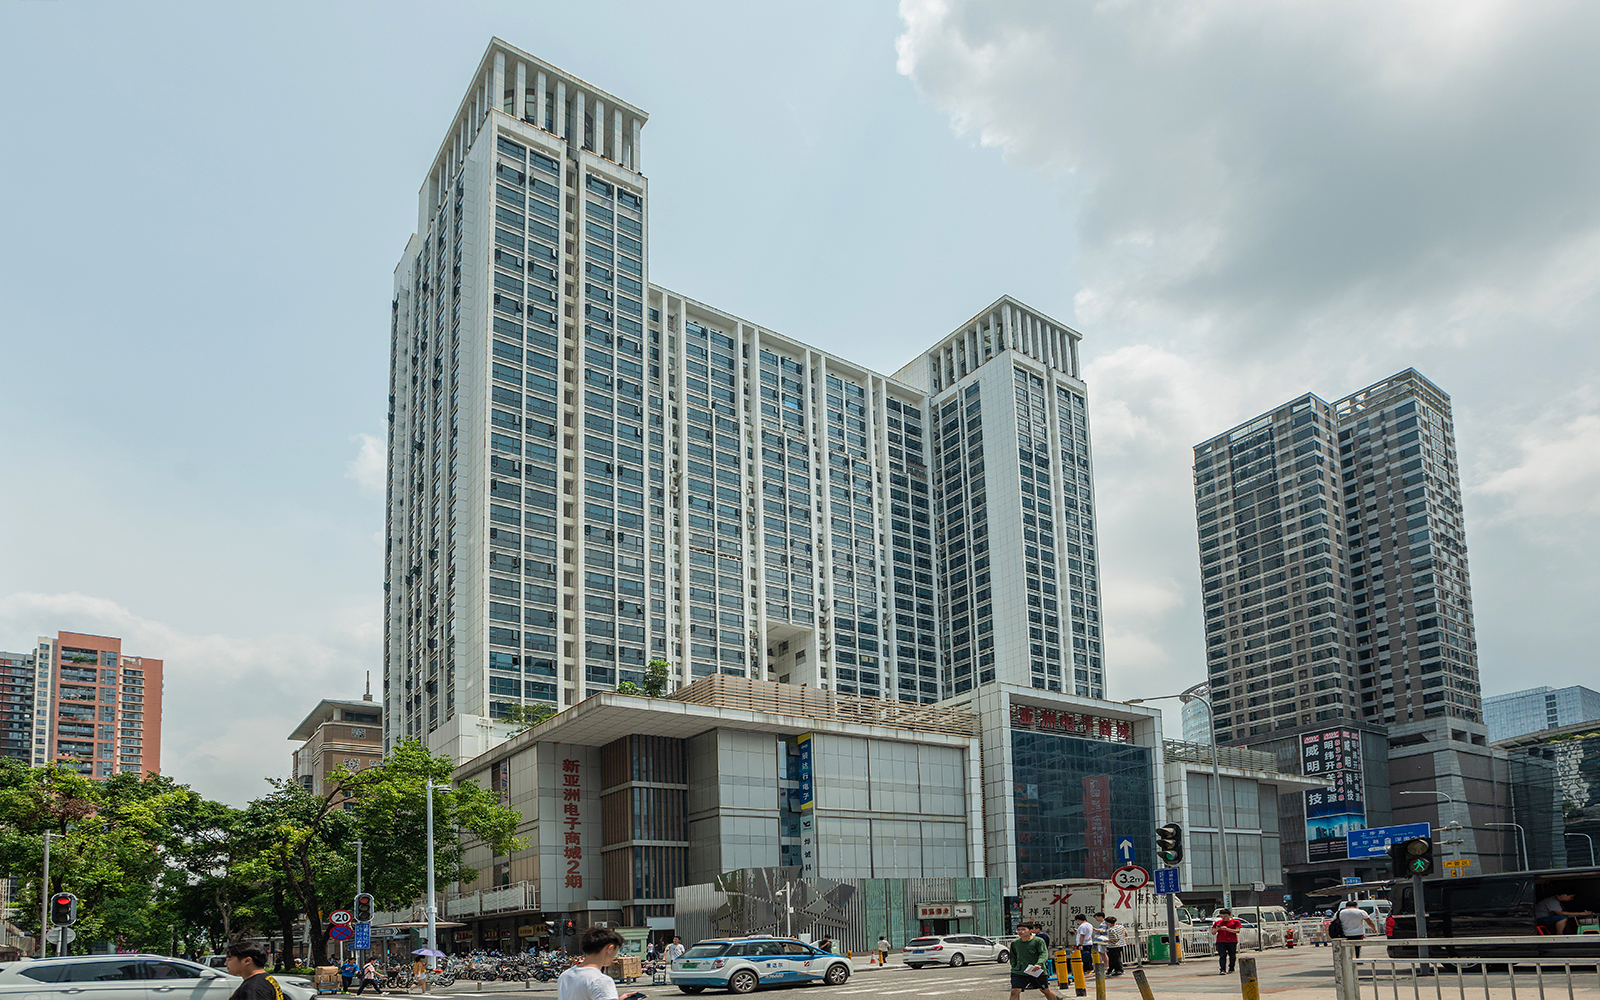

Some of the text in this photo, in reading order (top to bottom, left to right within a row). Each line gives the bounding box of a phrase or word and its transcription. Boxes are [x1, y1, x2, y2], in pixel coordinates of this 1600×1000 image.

[1010, 705, 1131, 739] 亚洲电子商城
[1305, 744, 1323, 806] 威明技
[562, 758, 583, 889] 新亚洲电子商城2期
[1120, 873, 1143, 884] 3.2m
[334, 913, 349, 922] 20
